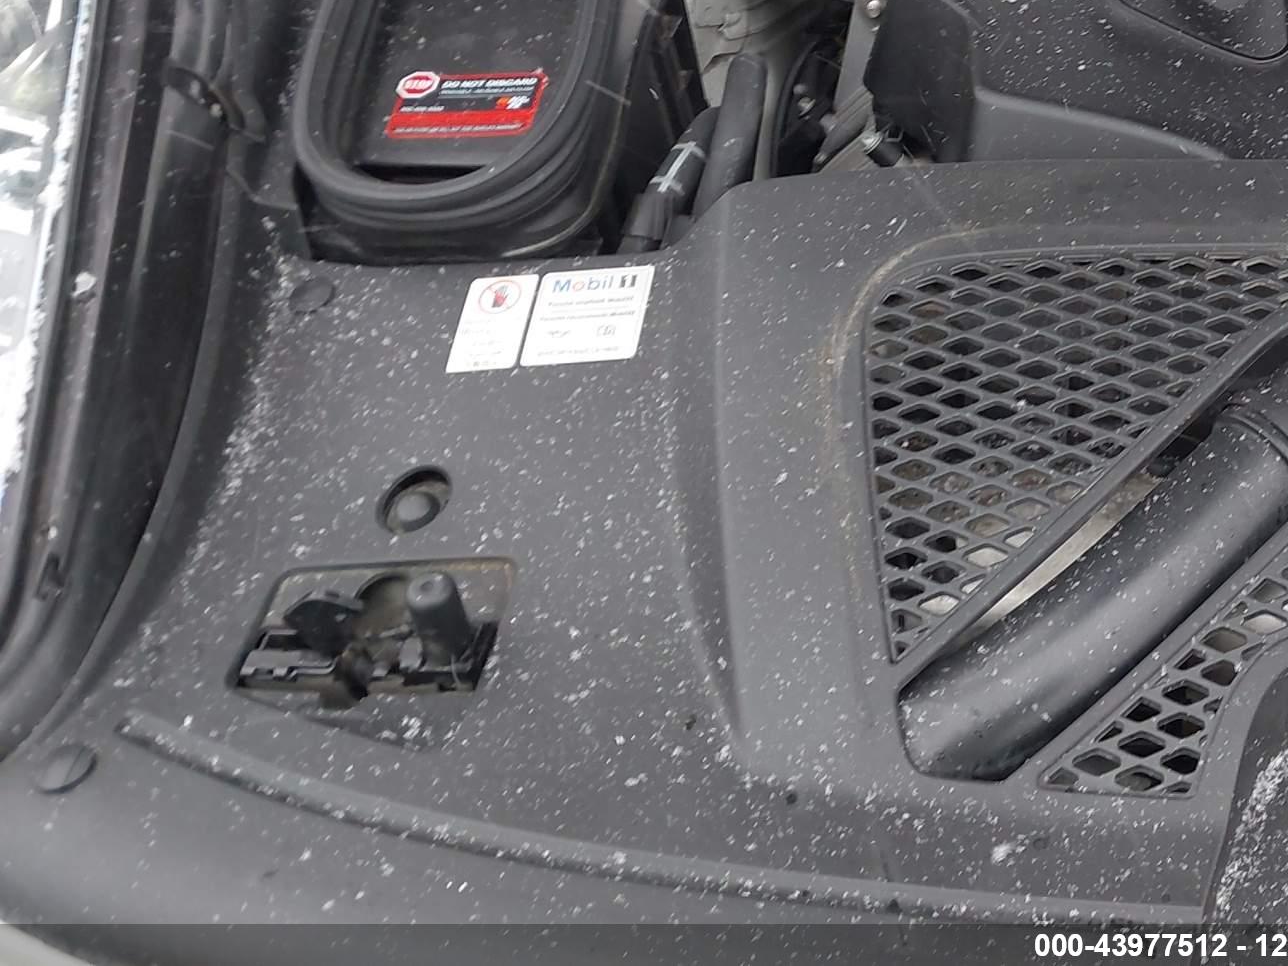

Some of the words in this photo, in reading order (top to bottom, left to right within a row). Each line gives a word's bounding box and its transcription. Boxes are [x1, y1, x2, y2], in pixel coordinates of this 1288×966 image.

[403, 79, 433, 90] STOP
[461, 79, 486, 88] NOT
[486, 77, 539, 87] DISCARD
[552, 275, 614, 293] Mobil
